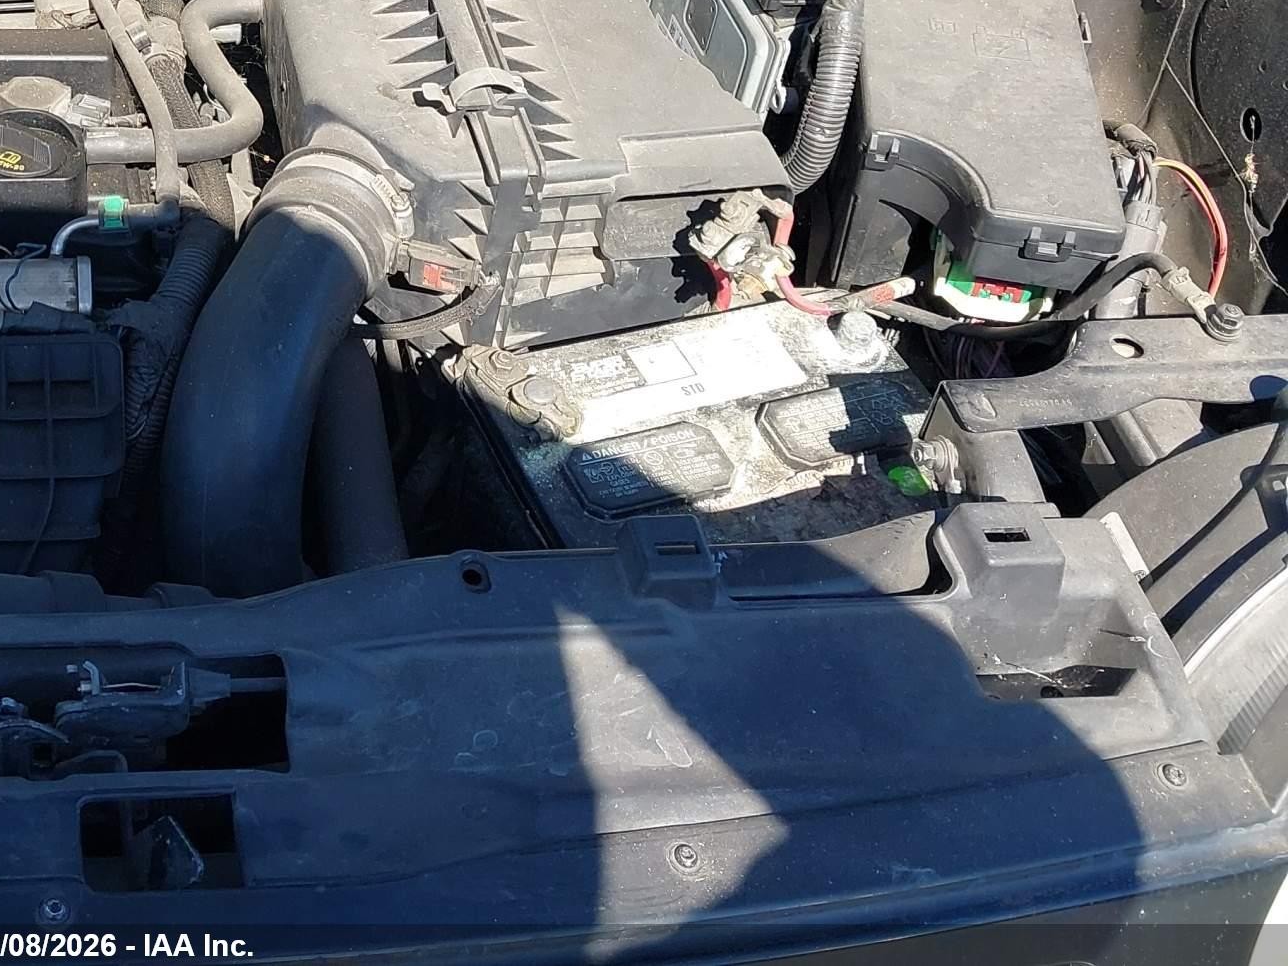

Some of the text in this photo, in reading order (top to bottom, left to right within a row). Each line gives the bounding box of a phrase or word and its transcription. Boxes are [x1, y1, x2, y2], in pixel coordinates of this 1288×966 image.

[680, 382, 705, 396] STD
[592, 441, 641, 458] DANGER
[652, 429, 696, 446] POISON
